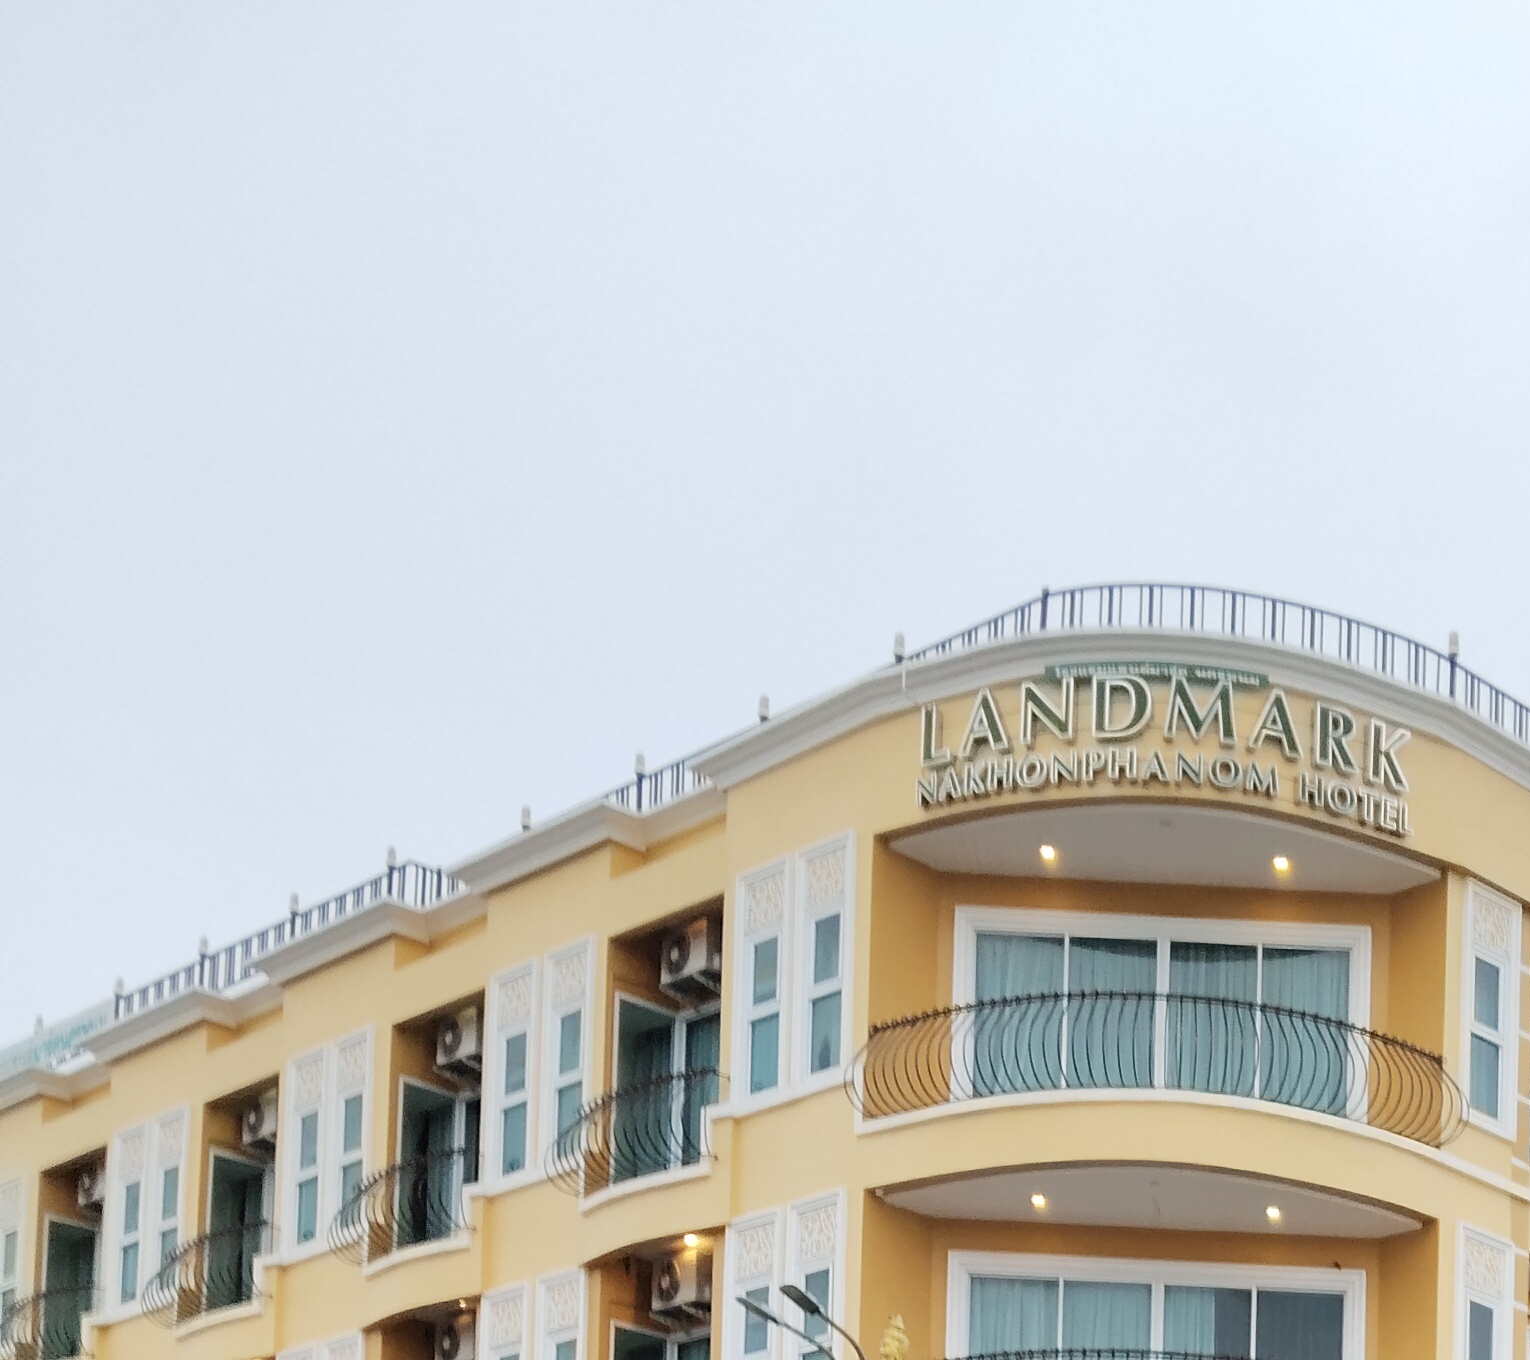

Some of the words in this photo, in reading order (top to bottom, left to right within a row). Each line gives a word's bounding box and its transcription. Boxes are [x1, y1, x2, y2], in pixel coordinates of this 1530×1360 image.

[919, 675, 1412, 793] LANDMARK
[916, 747, 1280, 808] NAKHONPHANOM
[1300, 772, 1414, 837] HOTEL
